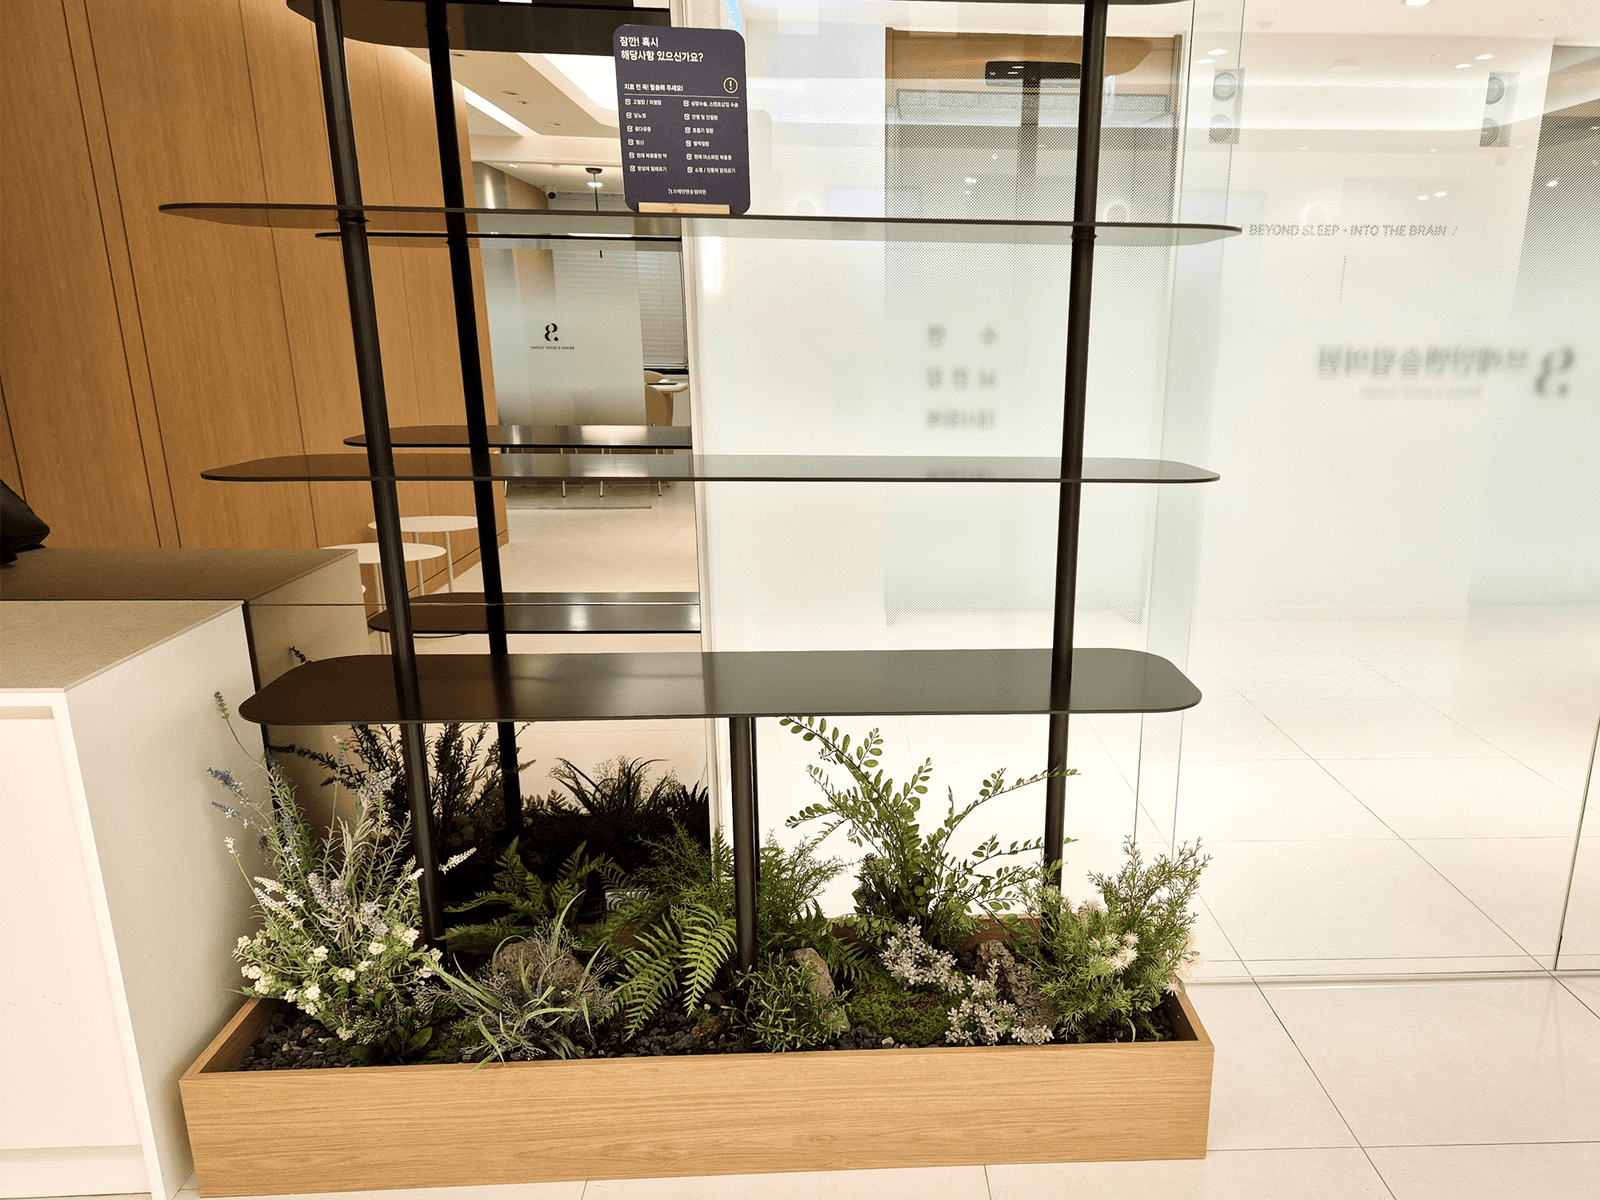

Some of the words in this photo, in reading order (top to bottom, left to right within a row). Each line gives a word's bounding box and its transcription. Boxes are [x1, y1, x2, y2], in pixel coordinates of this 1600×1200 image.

[619, 36, 640, 47] 잠깐!
[642, 37, 659, 48] 혹시
[620, 50, 655, 61] 해당사항
[656, 51, 704, 62] 있으신가요?
[1248, 224, 1300, 236] BEYOND
[1301, 224, 1340, 236] SLEEP
[1350, 224, 1379, 236] INTO
[1382, 224, 1406, 236] THE
[1408, 224, 1447, 236] BRAIN
